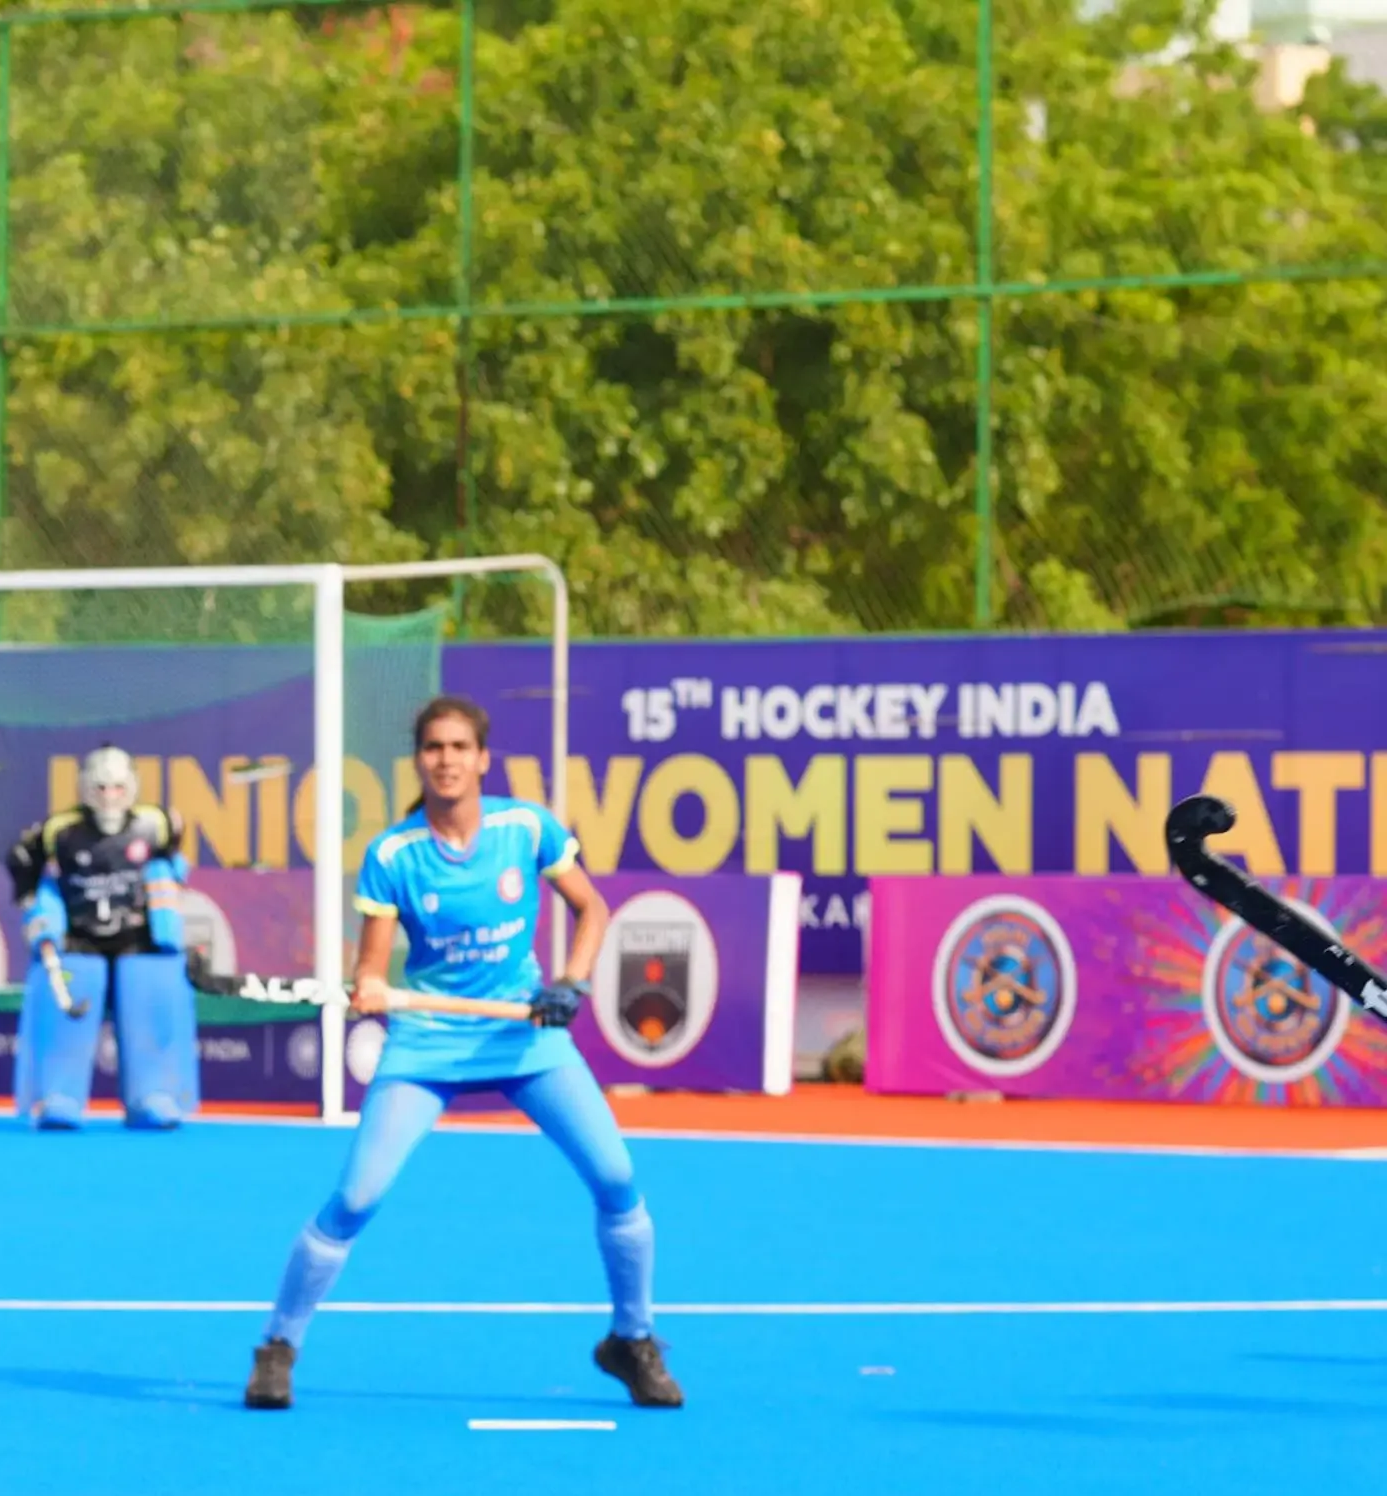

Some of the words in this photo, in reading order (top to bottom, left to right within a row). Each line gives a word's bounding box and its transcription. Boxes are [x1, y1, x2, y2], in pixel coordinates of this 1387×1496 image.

[621, 679, 712, 741] 15TH
[721, 685, 947, 740] HOCKEY
[958, 681, 1120, 738] INDIA
[504, 753, 1033, 877] WOMEN
